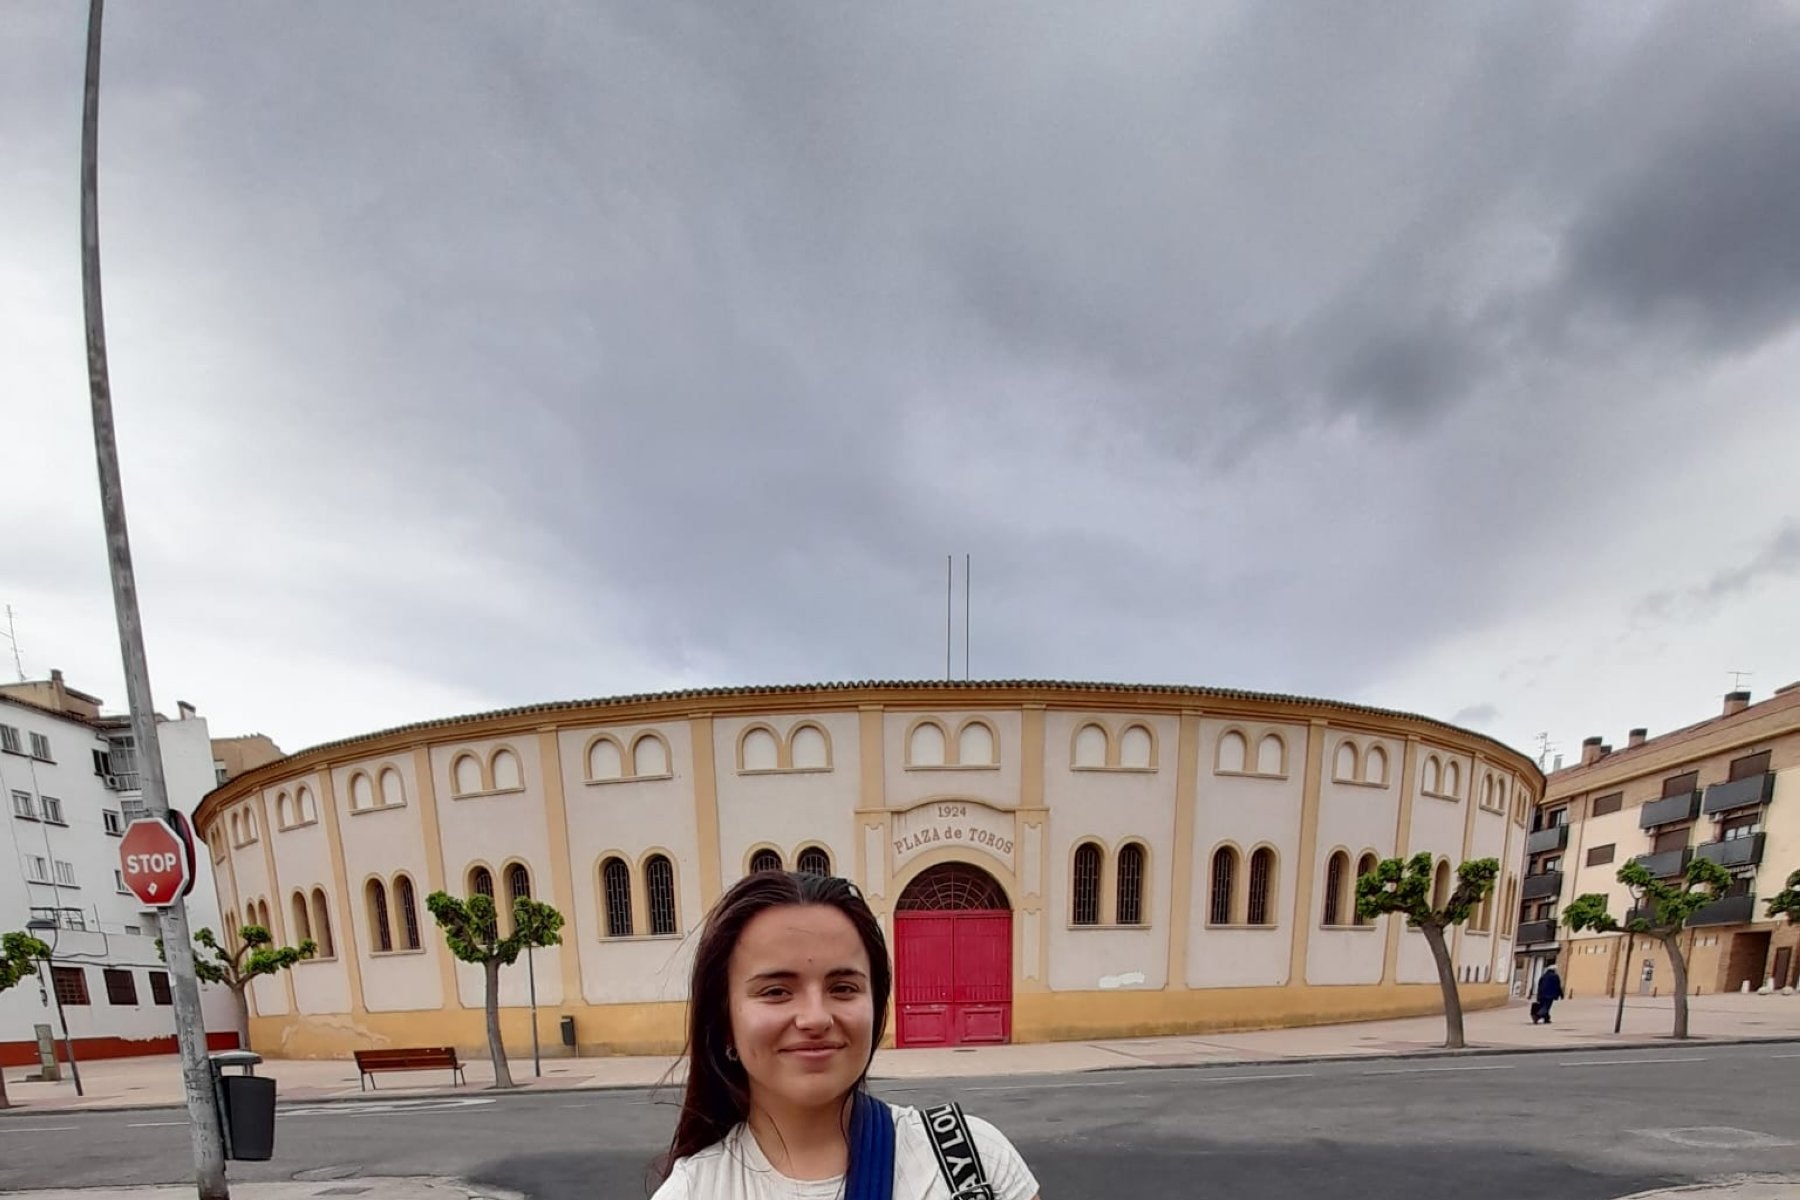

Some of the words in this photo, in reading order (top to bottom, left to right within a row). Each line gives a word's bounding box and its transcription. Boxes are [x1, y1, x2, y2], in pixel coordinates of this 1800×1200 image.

[938, 806, 967, 817] 1924
[894, 828, 941, 854] PLAZA
[945, 827, 962, 839] de
[969, 828, 1014, 854] TOROS
[127, 852, 176, 874] STOP
